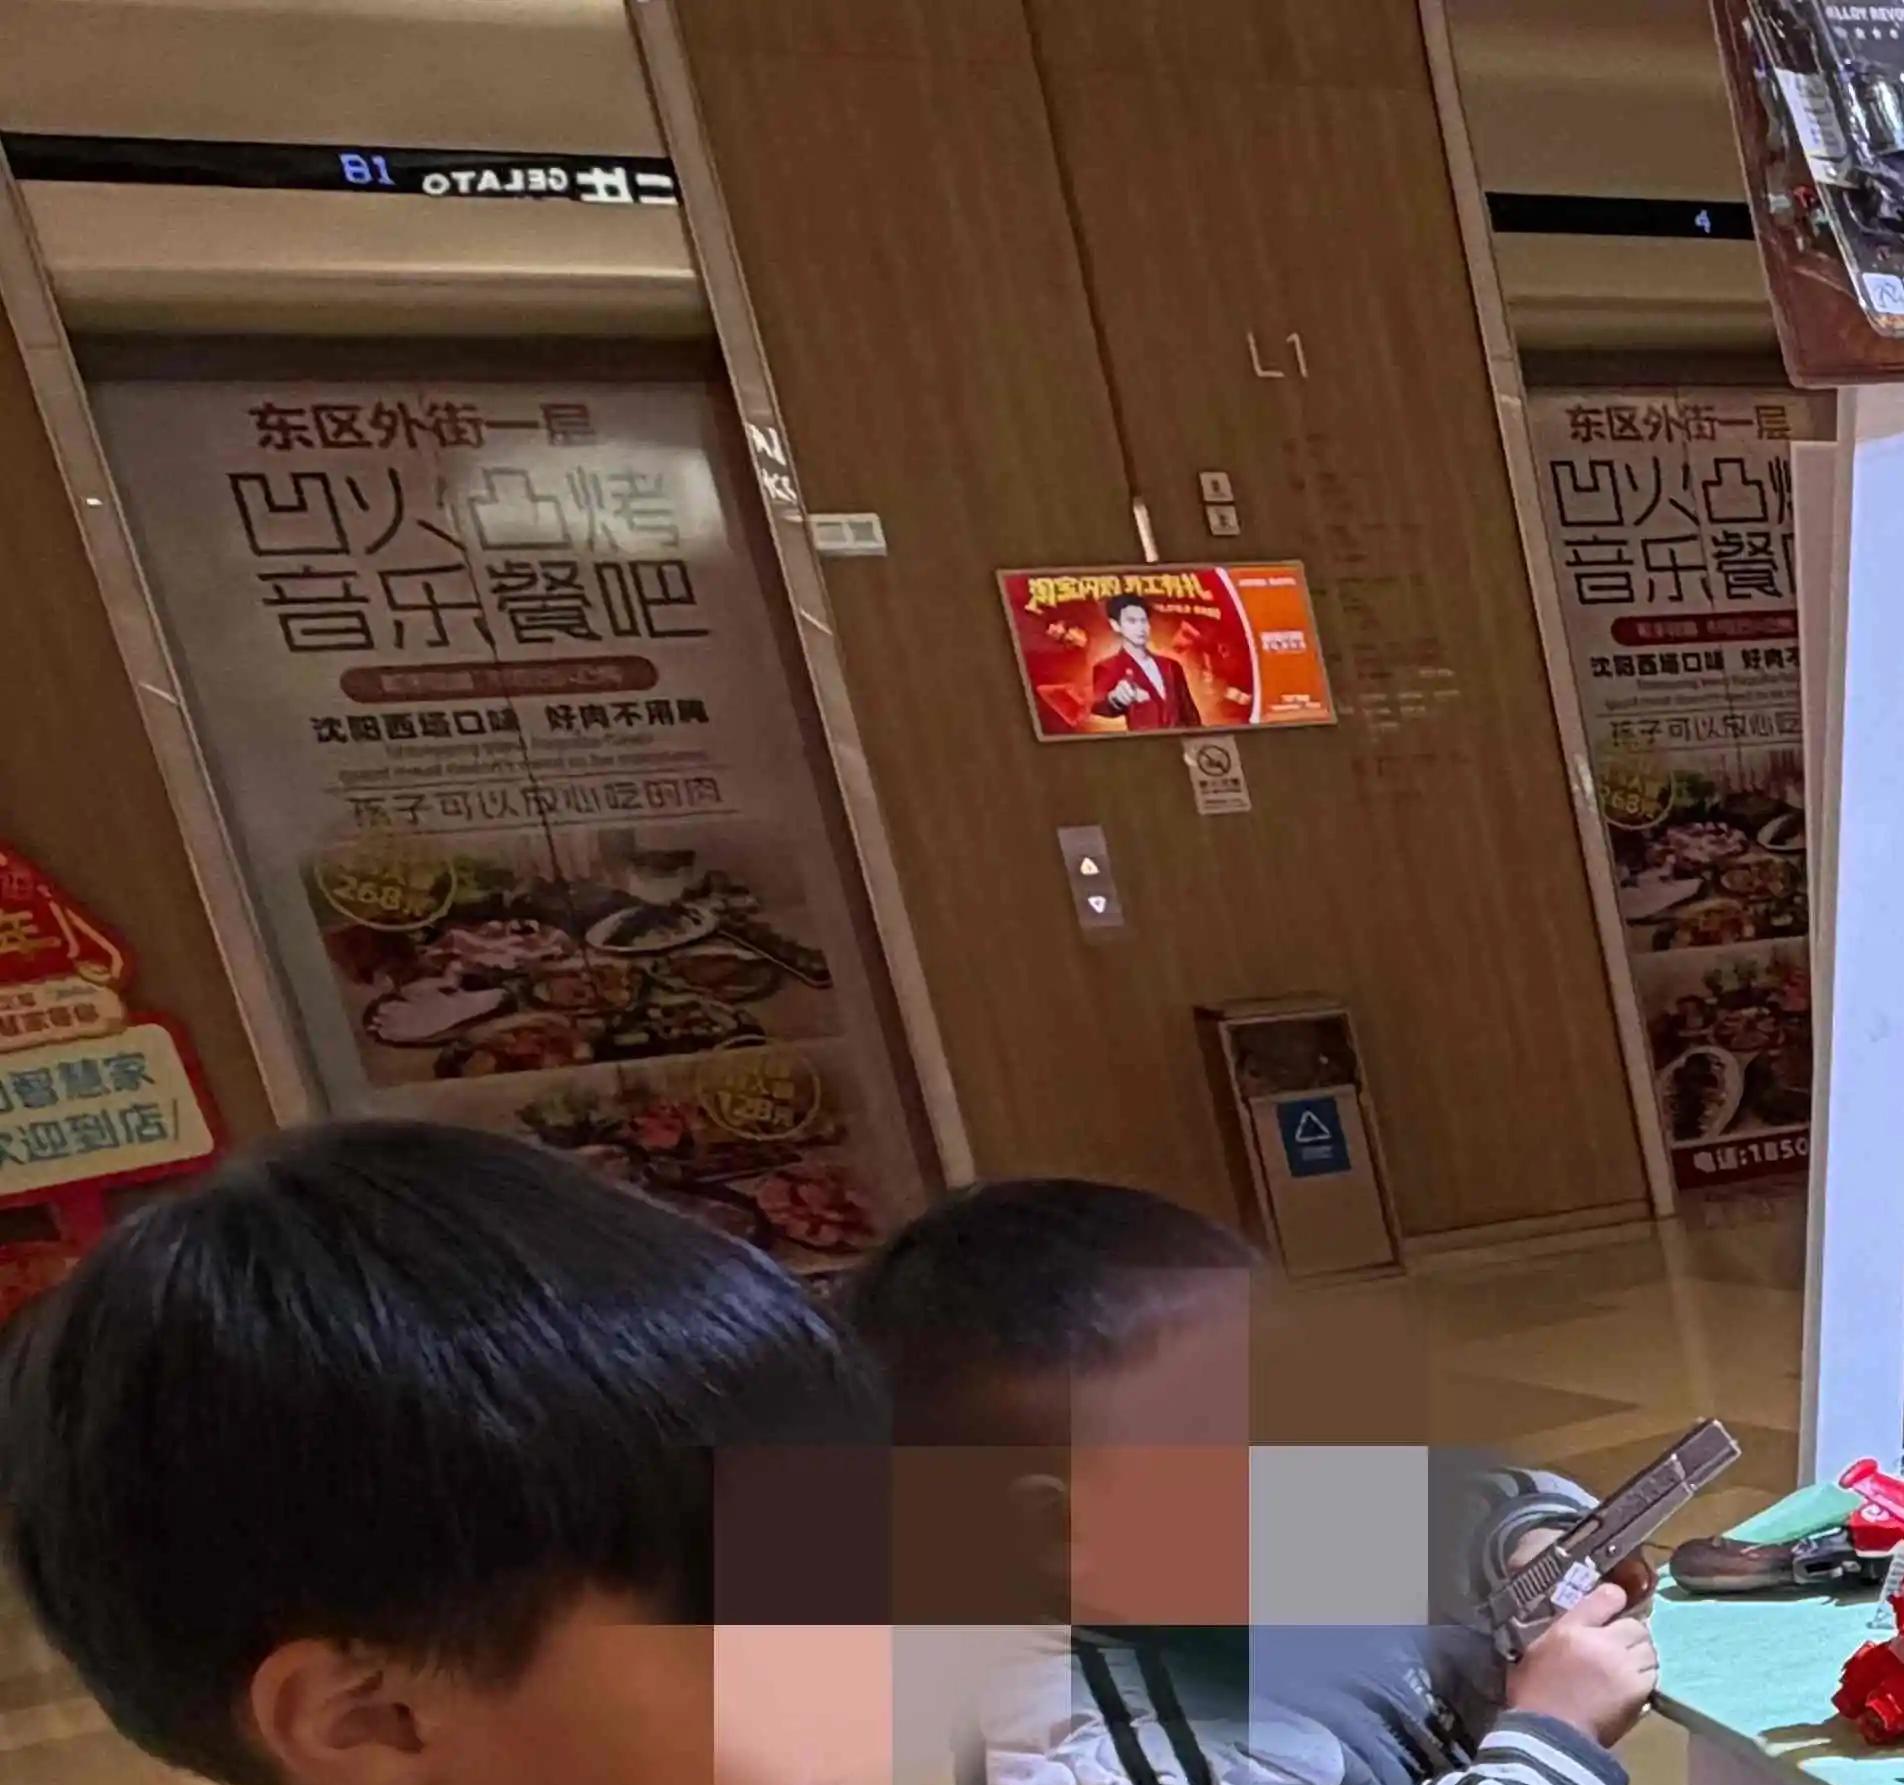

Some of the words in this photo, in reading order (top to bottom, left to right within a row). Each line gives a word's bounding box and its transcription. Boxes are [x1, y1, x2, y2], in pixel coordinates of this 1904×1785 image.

[1248, 331, 1309, 379] L1
[250, 401, 595, 451] 东区外街一层
[1566, 404, 1792, 443] 东区外街一层
[257, 560, 711, 654] 音乐餐吧
